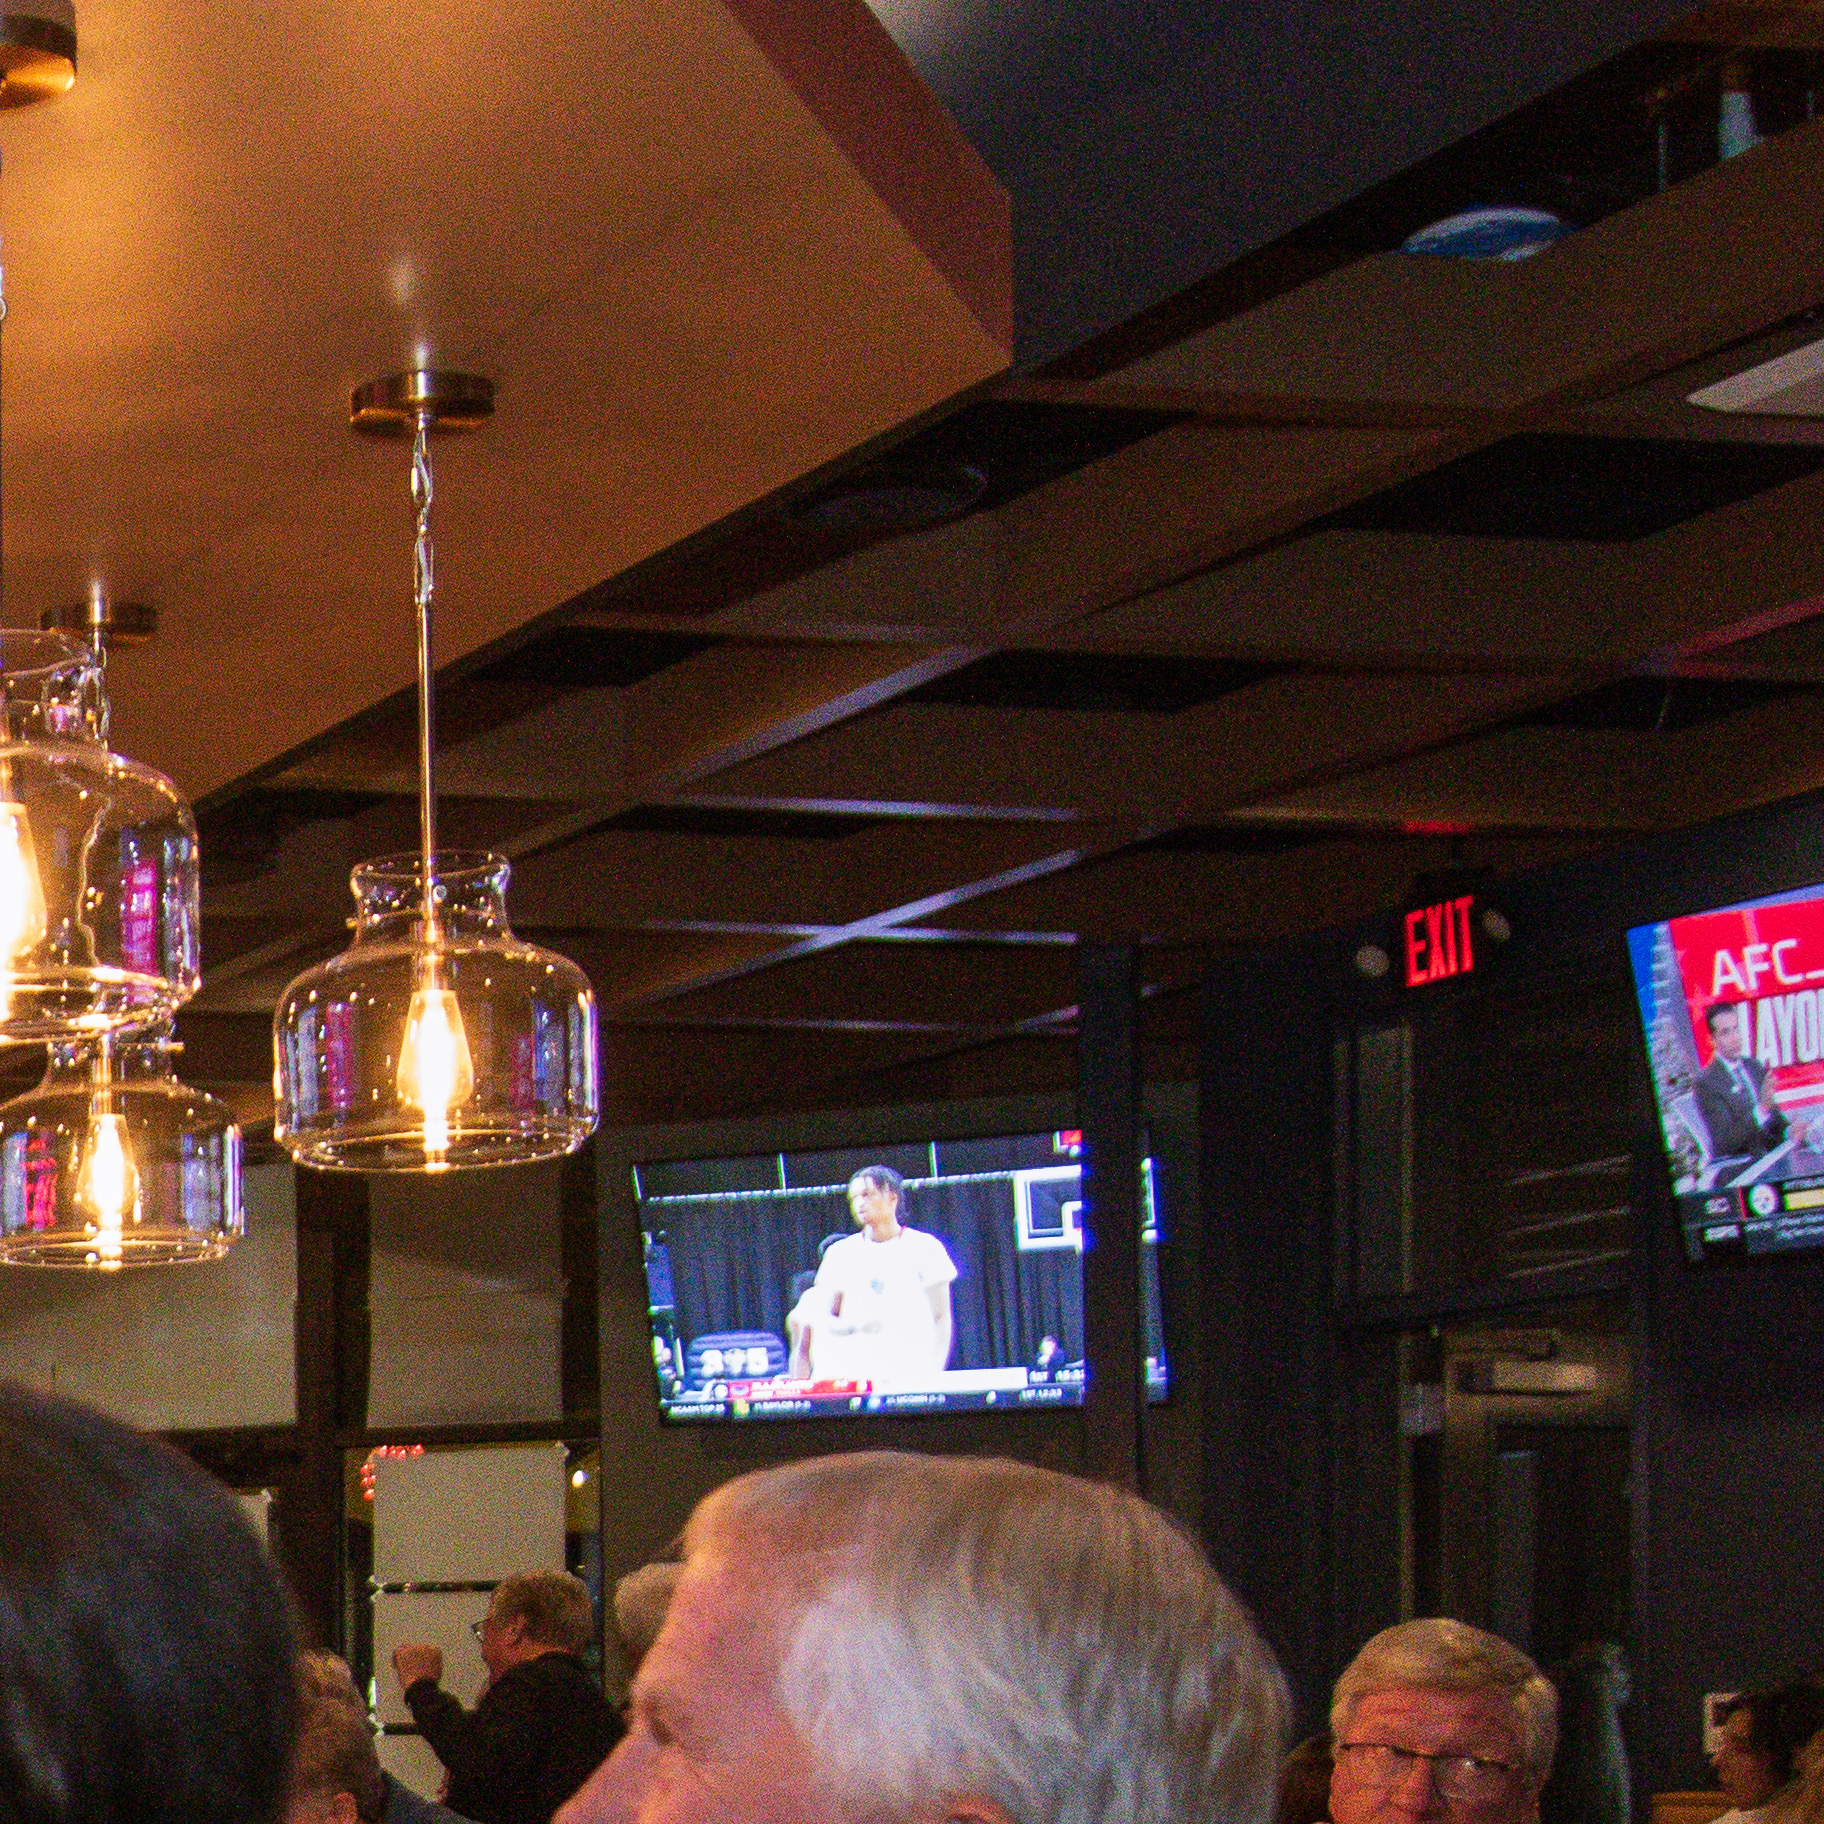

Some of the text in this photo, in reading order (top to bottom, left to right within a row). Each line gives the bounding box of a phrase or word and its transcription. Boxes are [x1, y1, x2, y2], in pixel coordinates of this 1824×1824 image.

[1405, 895, 1473, 987] EXIT
[1713, 938, 1799, 998] AFC
[1736, 988, 1824, 1068] LAYO
